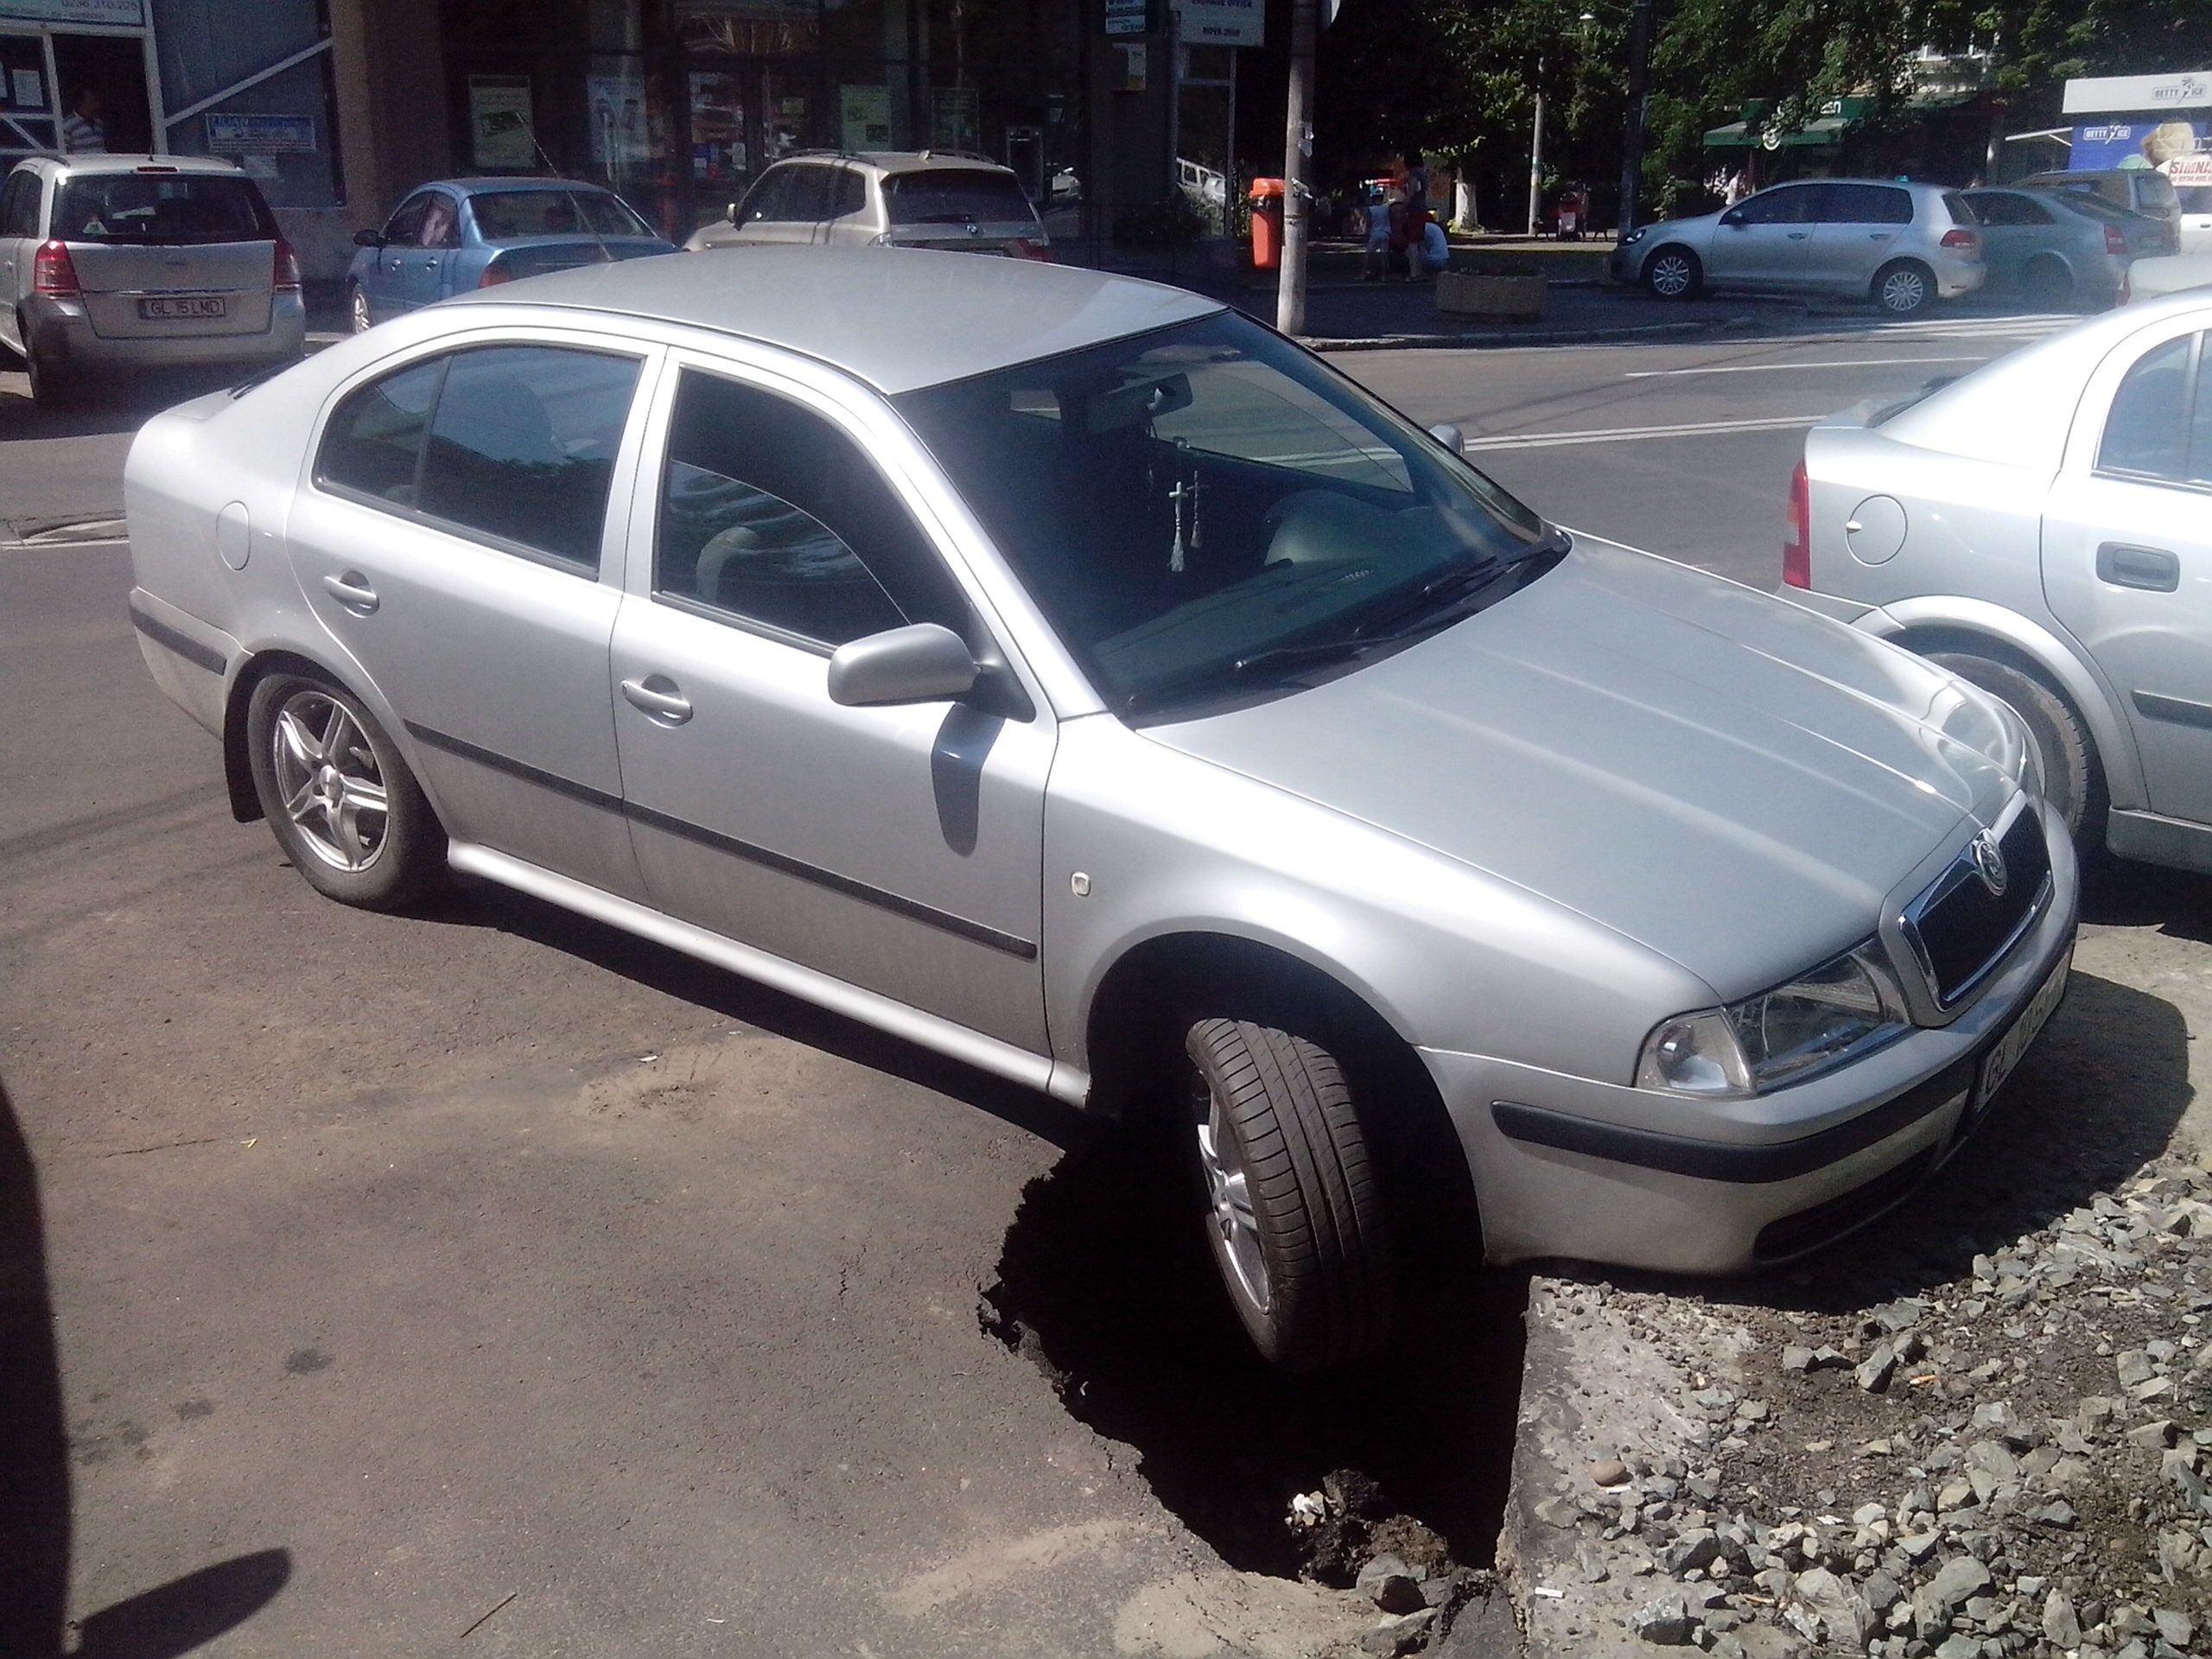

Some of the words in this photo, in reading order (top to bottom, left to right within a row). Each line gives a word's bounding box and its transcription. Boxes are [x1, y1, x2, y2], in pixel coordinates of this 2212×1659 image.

[2154, 89, 2178, 98] BETTY
[2191, 87, 2204, 96] ICE
[2117, 129, 2128, 137] ICE
